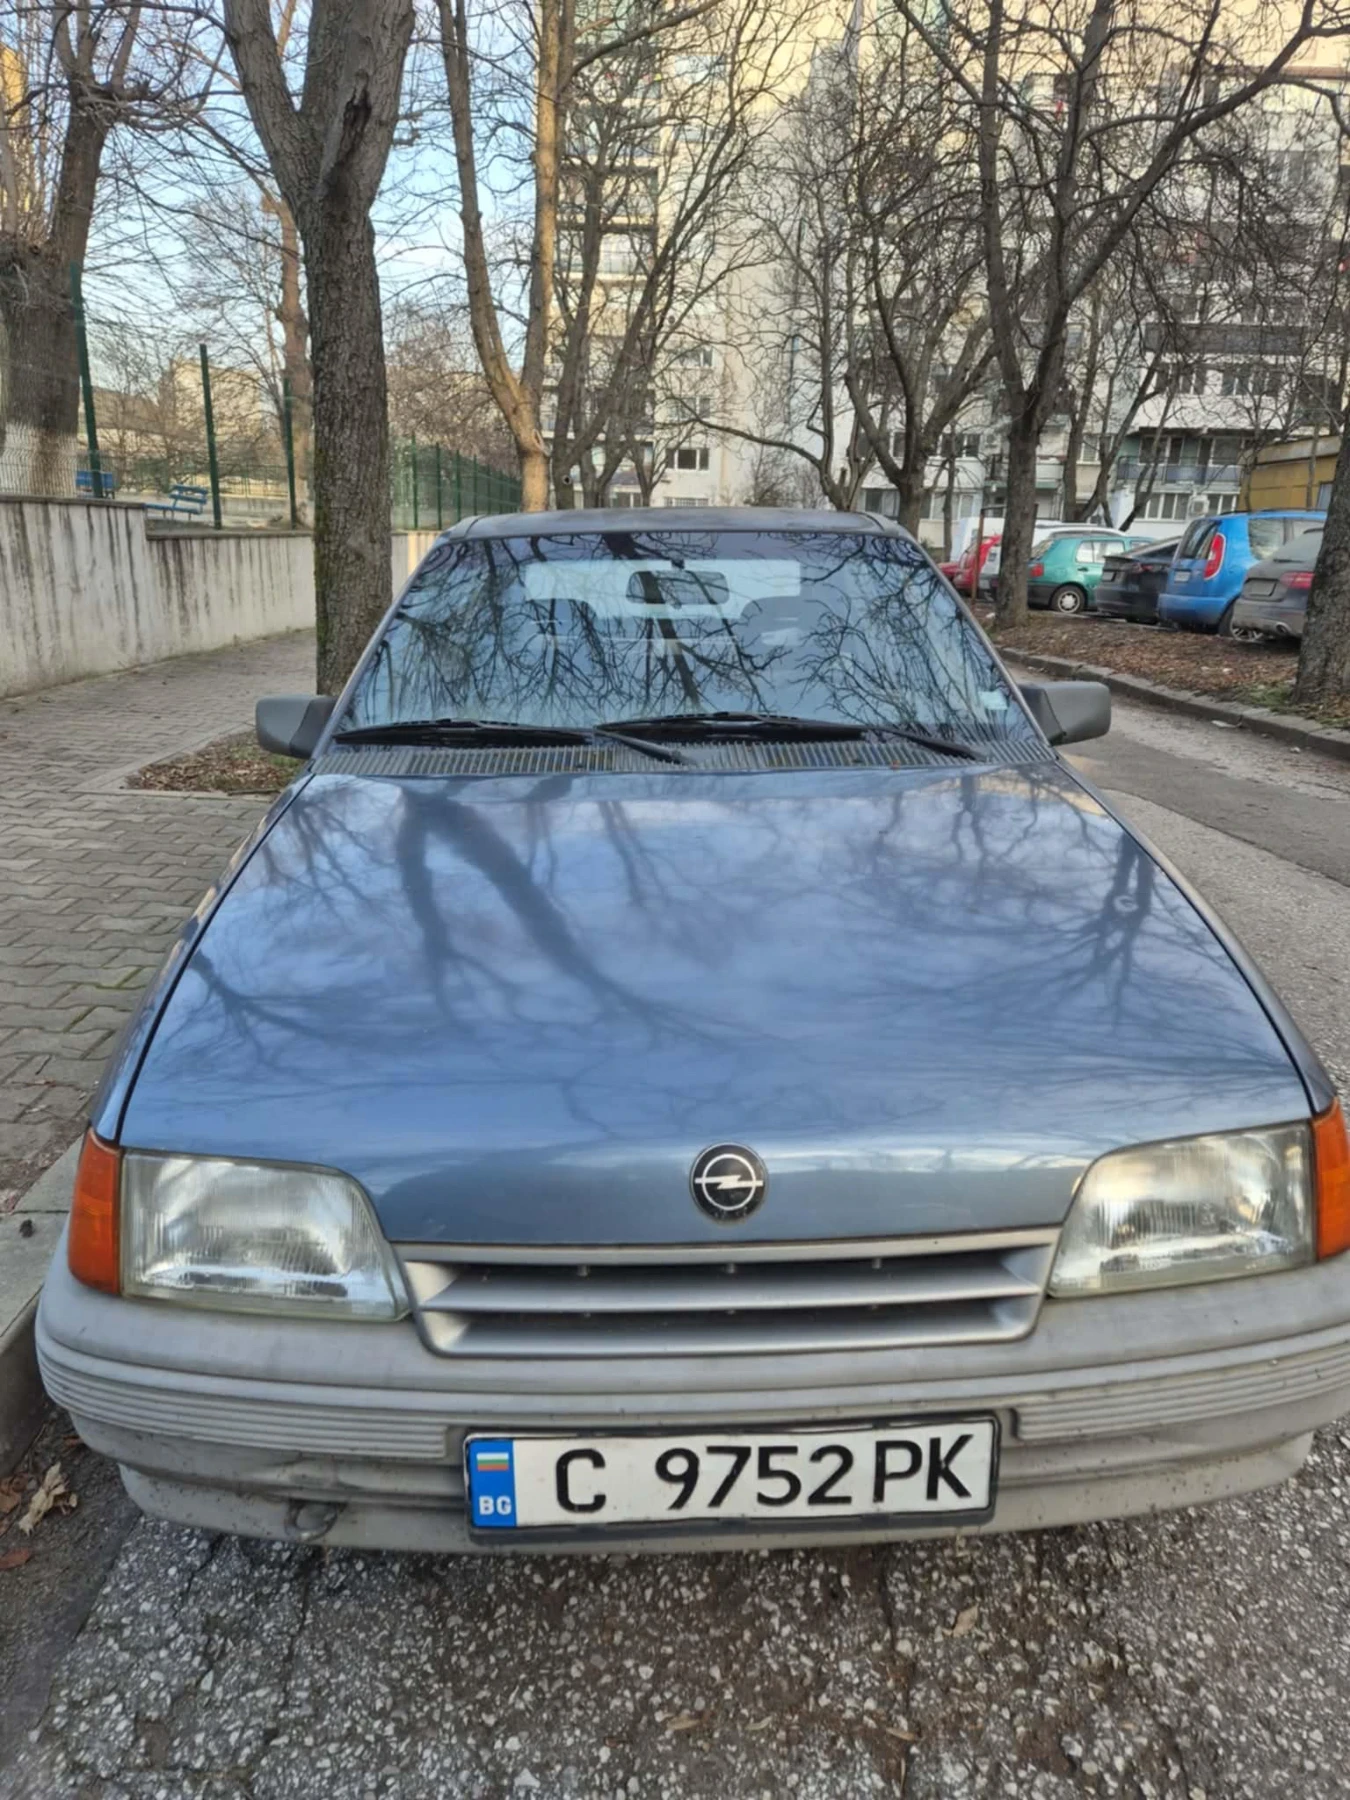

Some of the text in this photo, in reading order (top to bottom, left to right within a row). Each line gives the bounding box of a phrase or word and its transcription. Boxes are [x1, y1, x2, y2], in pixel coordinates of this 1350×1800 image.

[554, 1434, 973, 1513] C 9752 PK
[479, 1495, 512, 1516] BG
